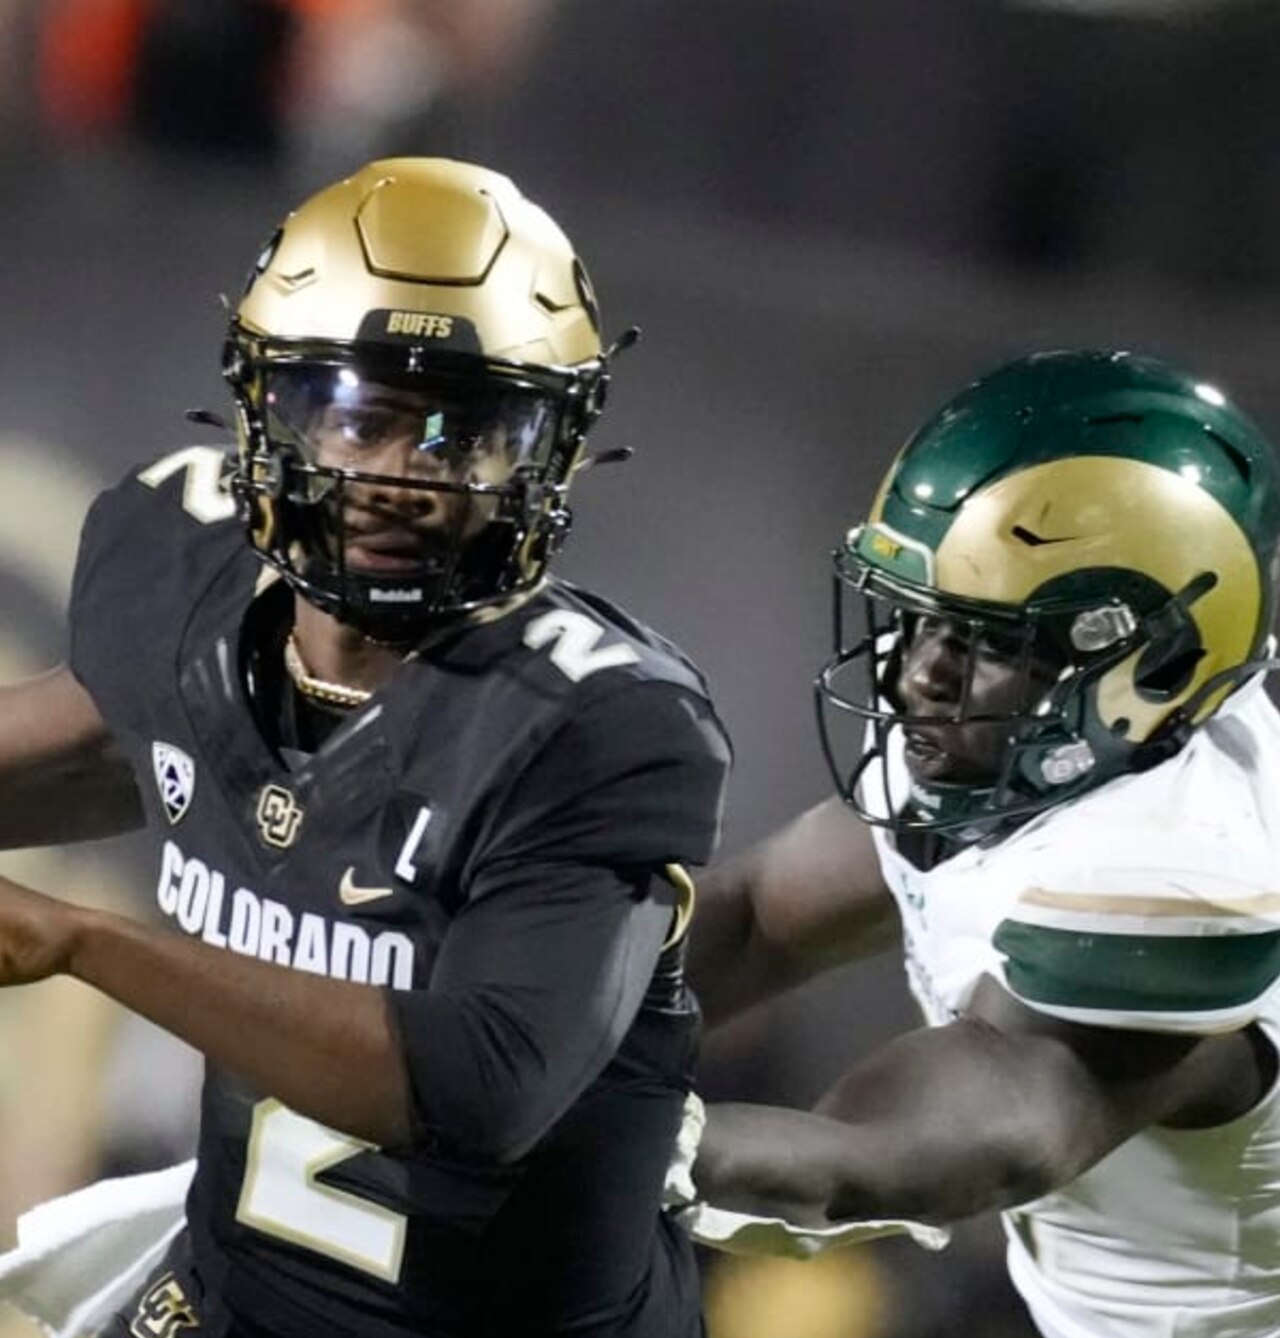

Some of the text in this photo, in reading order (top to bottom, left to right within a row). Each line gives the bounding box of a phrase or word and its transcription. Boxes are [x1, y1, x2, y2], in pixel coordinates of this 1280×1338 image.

[386, 311, 454, 338] BUFFS
[136, 446, 236, 524] 2
[522, 609, 641, 683] 2
[394, 806, 431, 883] L
[157, 839, 415, 991] COLORADO
